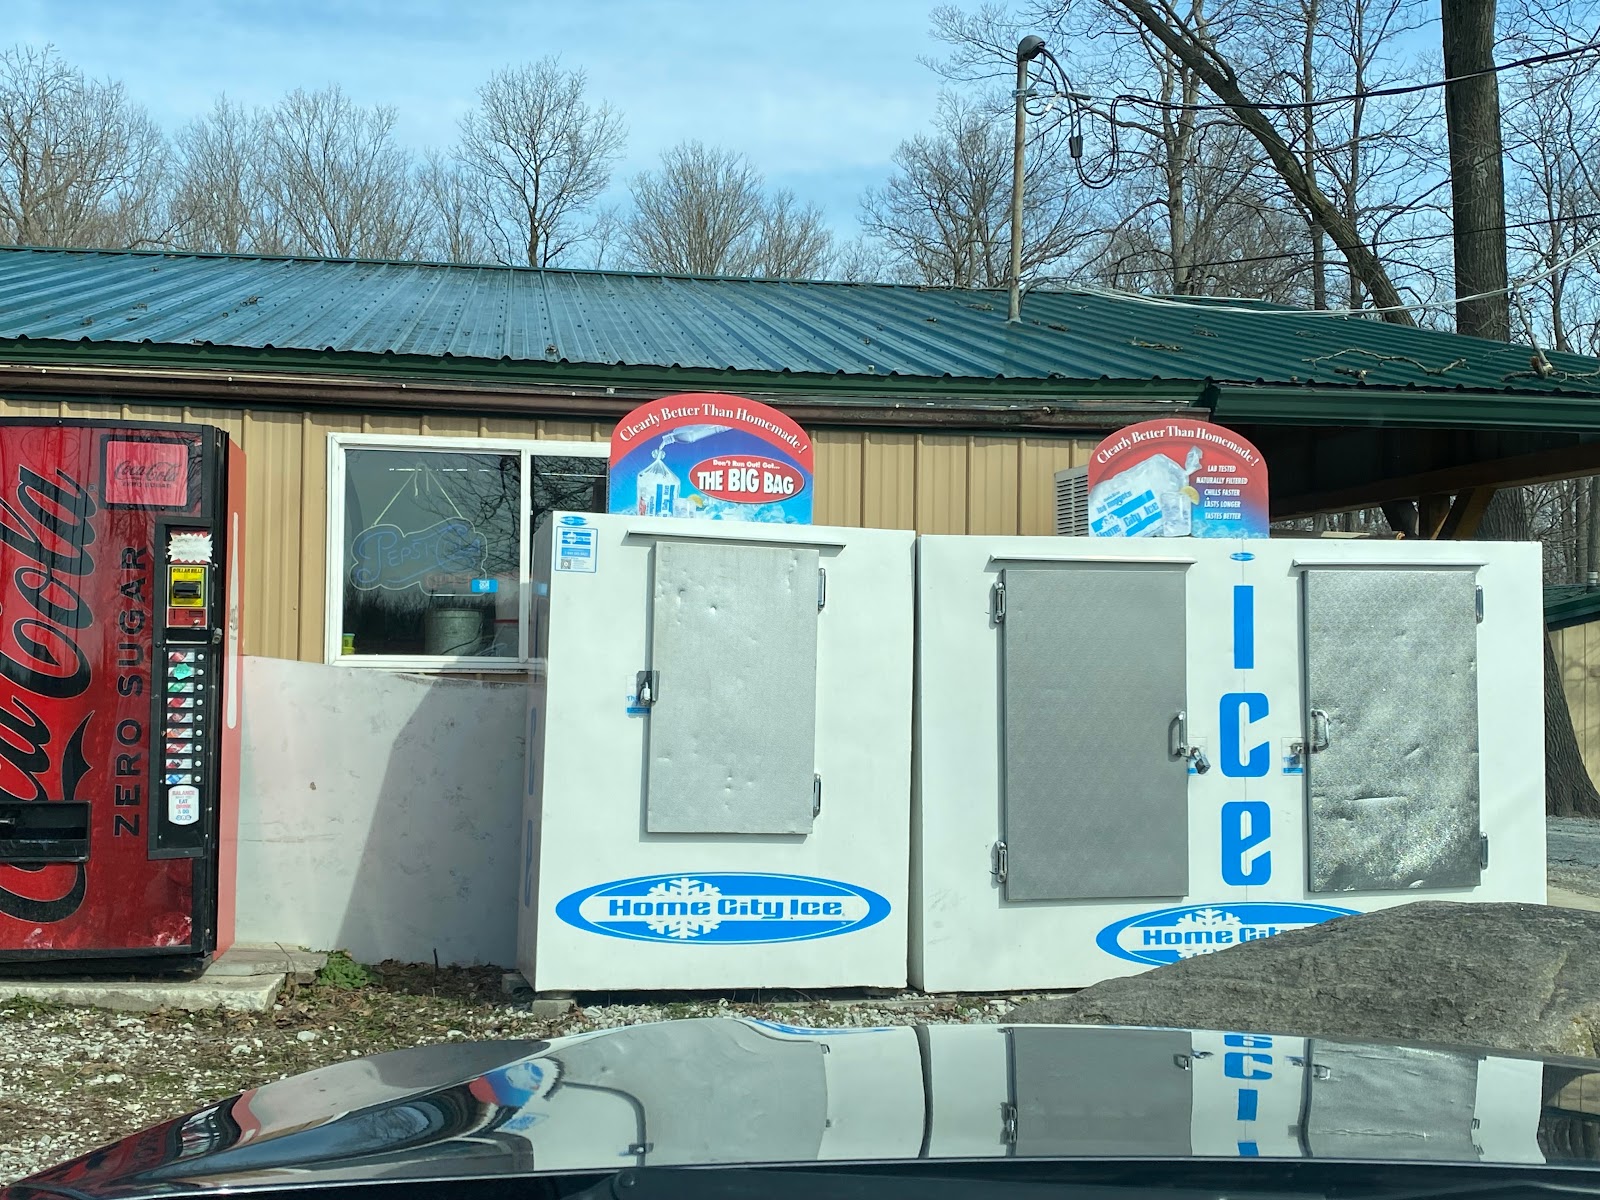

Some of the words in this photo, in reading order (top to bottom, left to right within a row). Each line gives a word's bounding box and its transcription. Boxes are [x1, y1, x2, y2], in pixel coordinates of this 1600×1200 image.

[619, 412, 660, 442] Clearly
[661, 406, 700, 421] Better
[701, 403, 734, 419] Than
[1096, 436, 1132, 464] Clearly
[1131, 429, 1166, 444] Better
[1166, 425, 1195, 438] Than
[713, 459, 731, 467] Don't
[732, 460, 745, 468] Run
[746, 461, 761, 469] Out!
[1207, 465, 1218, 473] LAB
[1218, 465, 1237, 473] TESTED
[697, 469, 724, 491] THE
[727, 467, 760, 493] BIG
[763, 470, 795, 495] BAG
[1195, 476, 1226, 484] NATURALLY
[1225, 477, 1249, 485] FILTERED
[1204, 488, 1222, 496] CHILLS
[1222, 489, 1241, 497] FASTER
[1143, 502, 1160, 515] Ice
[1204, 500, 1220, 508] LASTS
[1220, 500, 1242, 508] LONGER
[1205, 512, 1223, 520] TASTES
[1222, 512, 1242, 520] BETTER
[117, 545, 148, 697] SUGAR
[113, 717, 142, 838] ZERO
[609, 899, 711, 916] Home
[717, 898, 784, 920] City
[790, 899, 842, 916] Ice
[1143, 929, 1233, 946] Home
[1239, 926, 1288, 943] Cit
